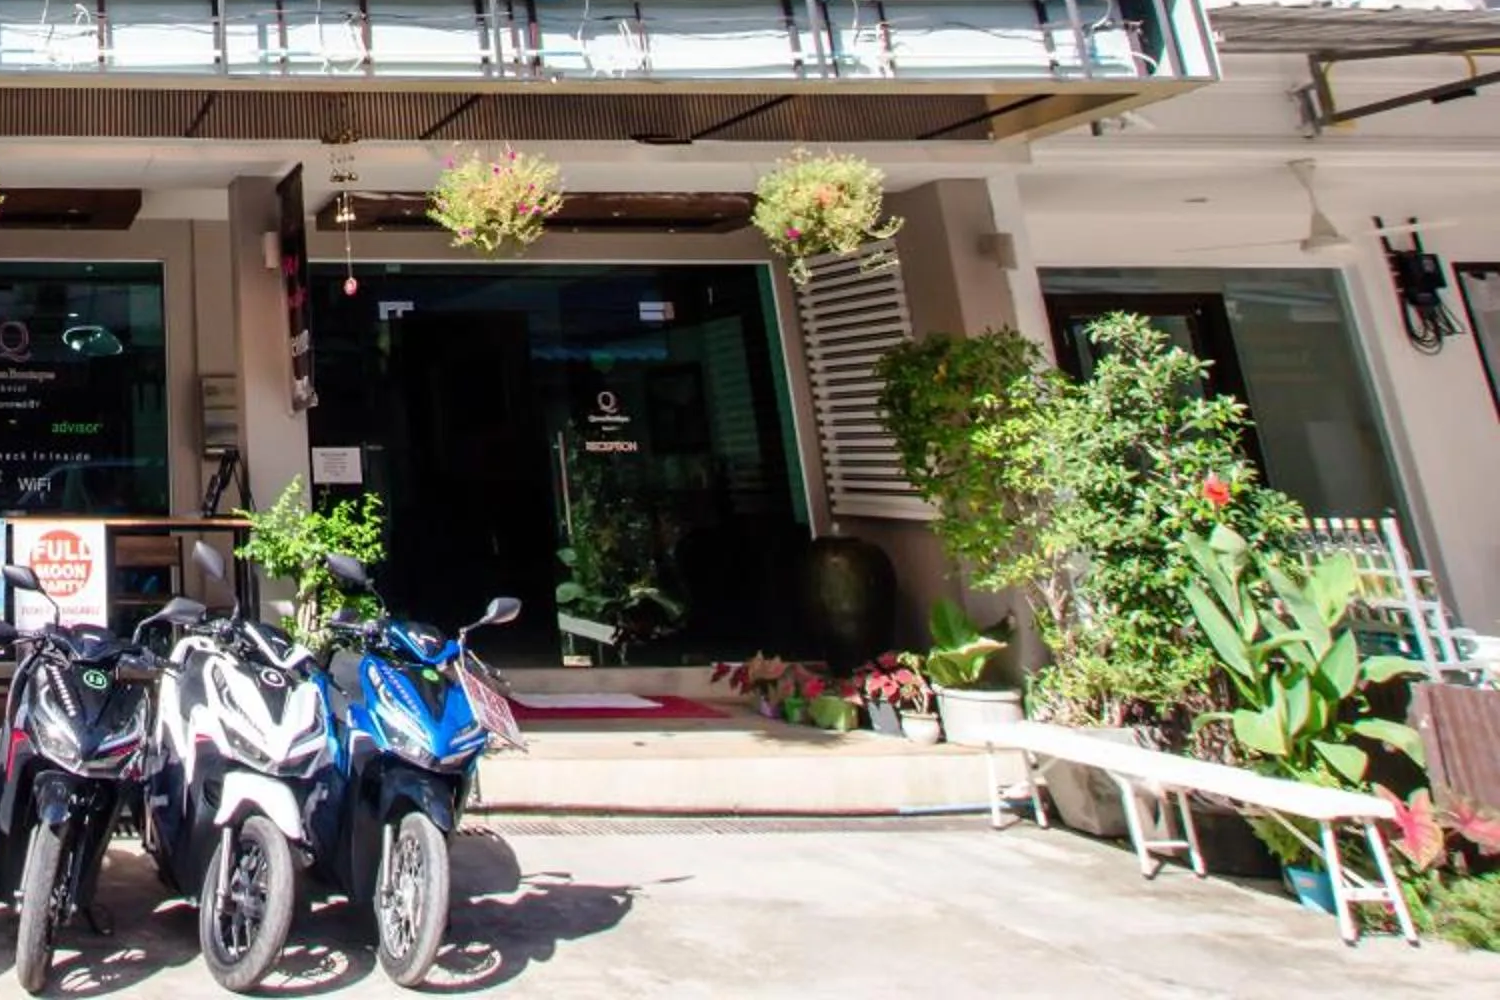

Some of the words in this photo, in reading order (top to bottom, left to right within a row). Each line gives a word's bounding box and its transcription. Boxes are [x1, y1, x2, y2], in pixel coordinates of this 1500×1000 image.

[52, 421, 100, 433] advisor
[31, 538, 92, 560] FULL
[35, 563, 88, 580] MOON
